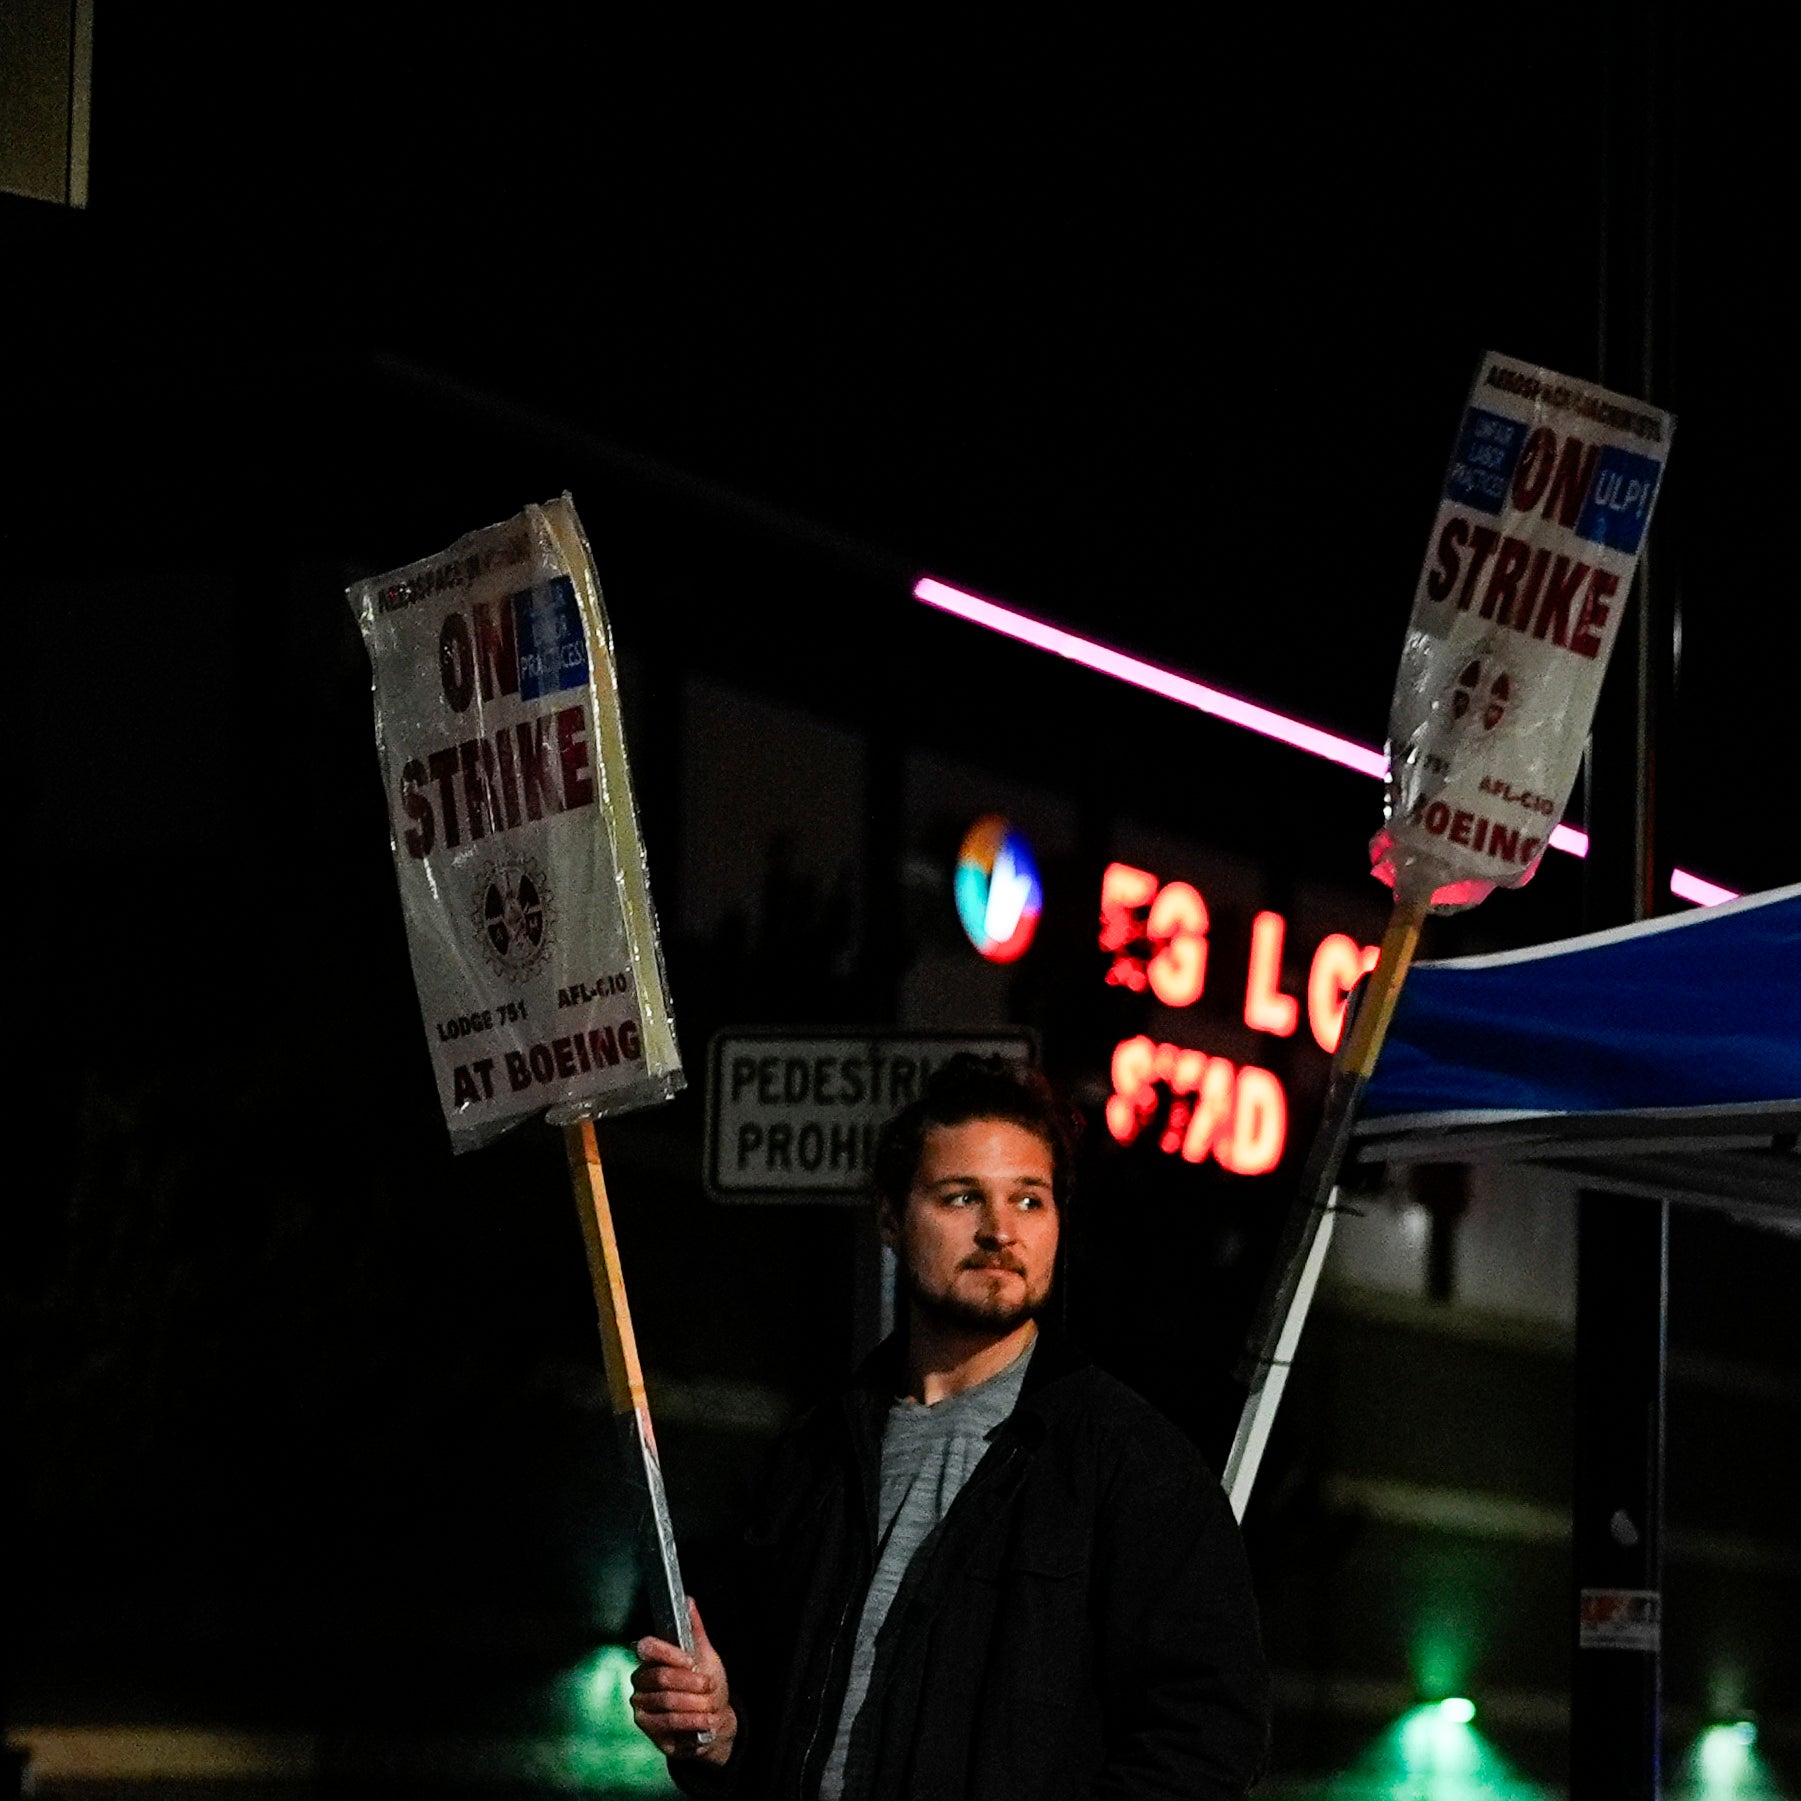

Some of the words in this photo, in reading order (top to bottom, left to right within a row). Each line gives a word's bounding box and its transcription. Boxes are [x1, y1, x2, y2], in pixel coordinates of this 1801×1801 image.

[1511, 427, 1600, 529] ON
[1594, 469, 1651, 520] ULP!
[1427, 517, 1619, 660] STRIKE
[439, 599, 519, 714] ON
[402, 705, 594, 859] STRIKE
[437, 1010, 493, 1042] LODGE
[496, 1001, 529, 1027] 751
[558, 973, 628, 1008] AFL-CIO
[454, 1058, 494, 1106] AT
[504, 1019, 641, 1092] BOEING
[731, 1055, 931, 1105] PEDESTRI
[738, 1122, 874, 1171] PROHI
